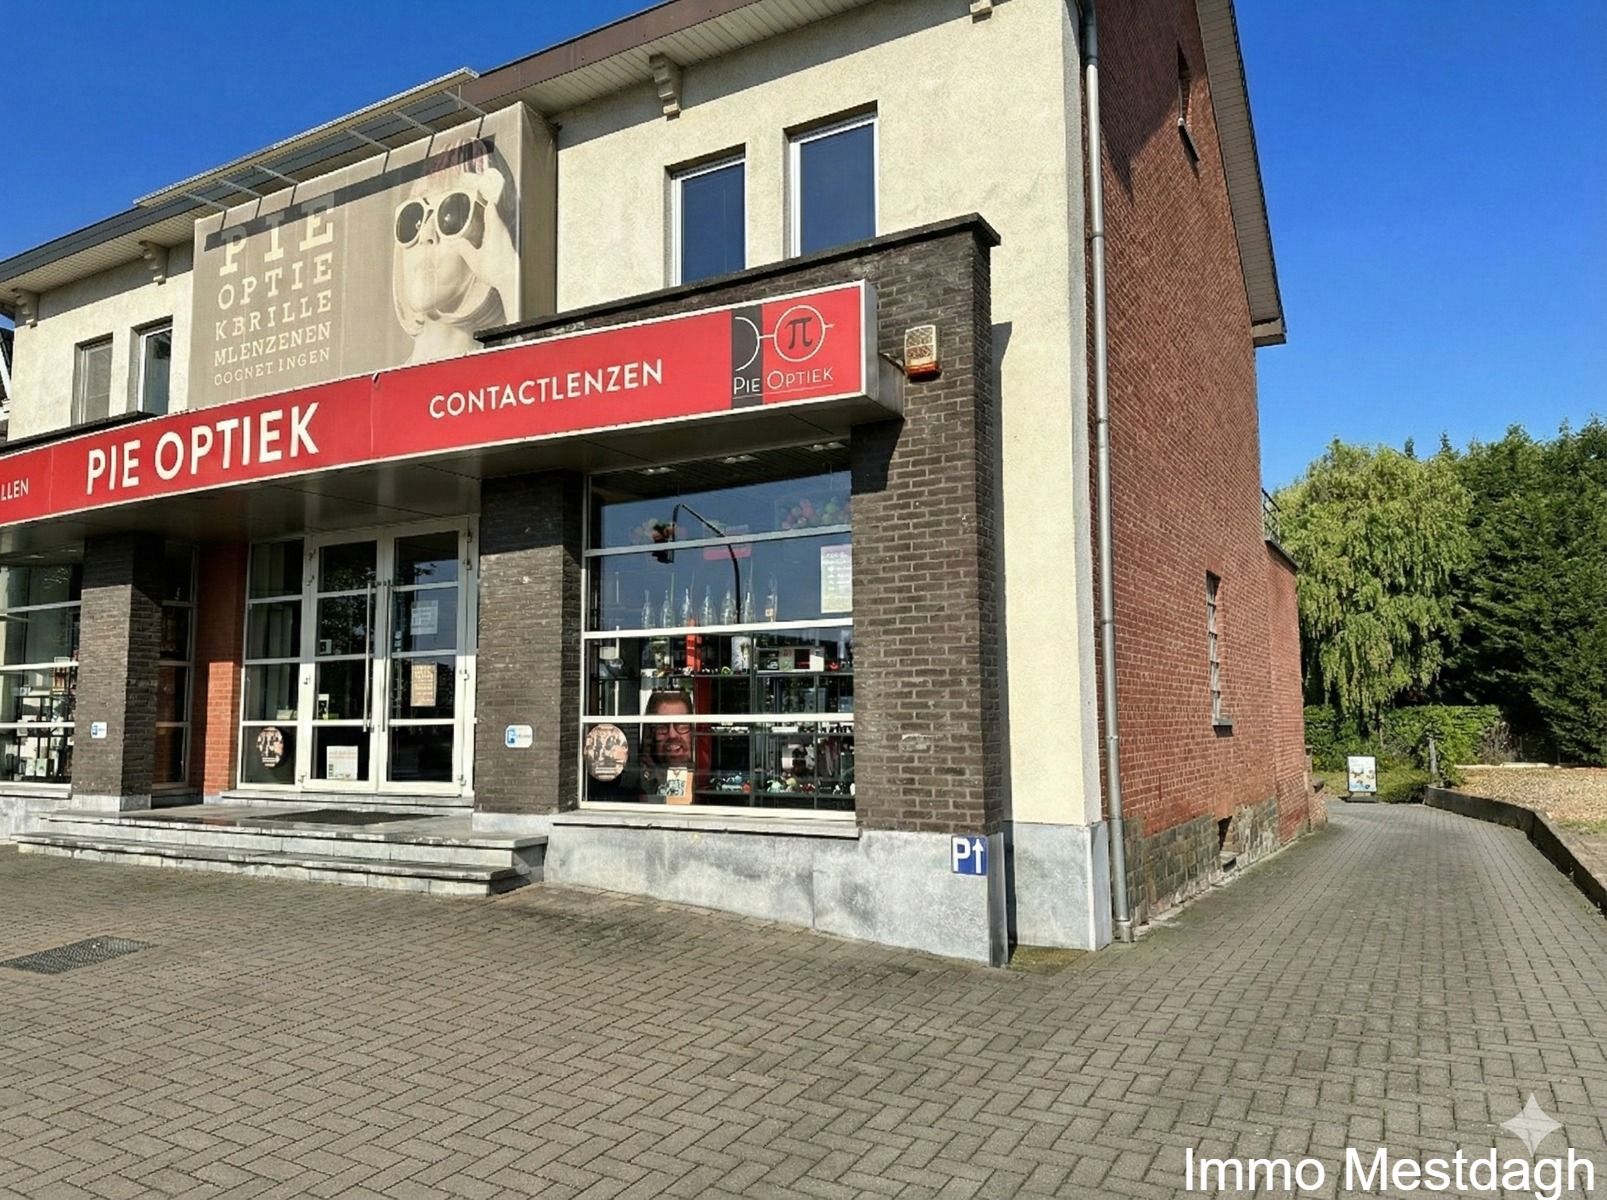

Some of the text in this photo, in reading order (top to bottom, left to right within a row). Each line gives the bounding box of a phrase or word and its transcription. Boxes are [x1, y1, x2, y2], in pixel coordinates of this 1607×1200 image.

[219, 192, 334, 276] PIE
[217, 251, 333, 310] OPTIE
[214, 321, 332, 367] MLENZENEN
[215, 289, 332, 341] KBRILLE
[429, 358, 663, 419] CONTACTLENZEN
[86, 402, 320, 495] PIE OPTIEK
[952, 837, 971, 872] P
